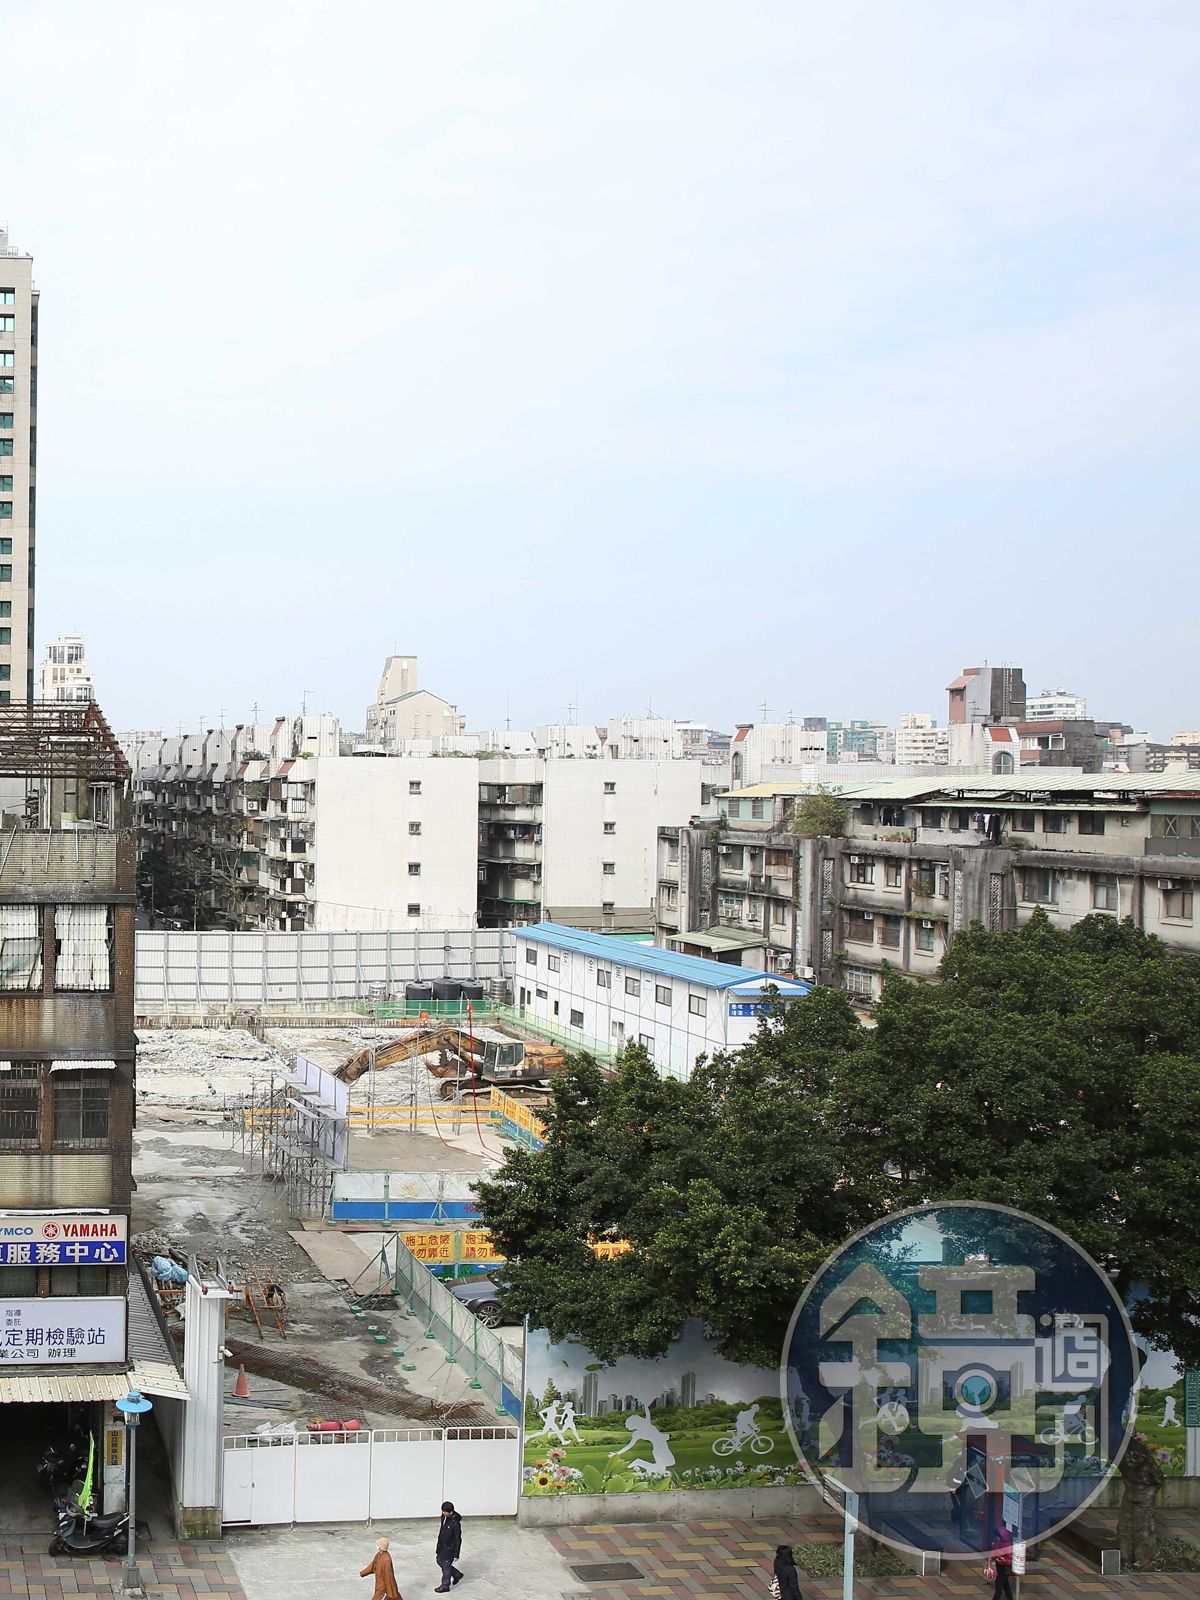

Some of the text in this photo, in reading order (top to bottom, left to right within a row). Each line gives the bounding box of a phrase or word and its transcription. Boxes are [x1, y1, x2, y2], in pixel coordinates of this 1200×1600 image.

[63, 1223, 118, 1238] YAMAHA
[405, 1234, 450, 1247] 施工危險
[5, 1309, 22, 1318] 指導
[47, 1348, 77, 1359] 辦理
